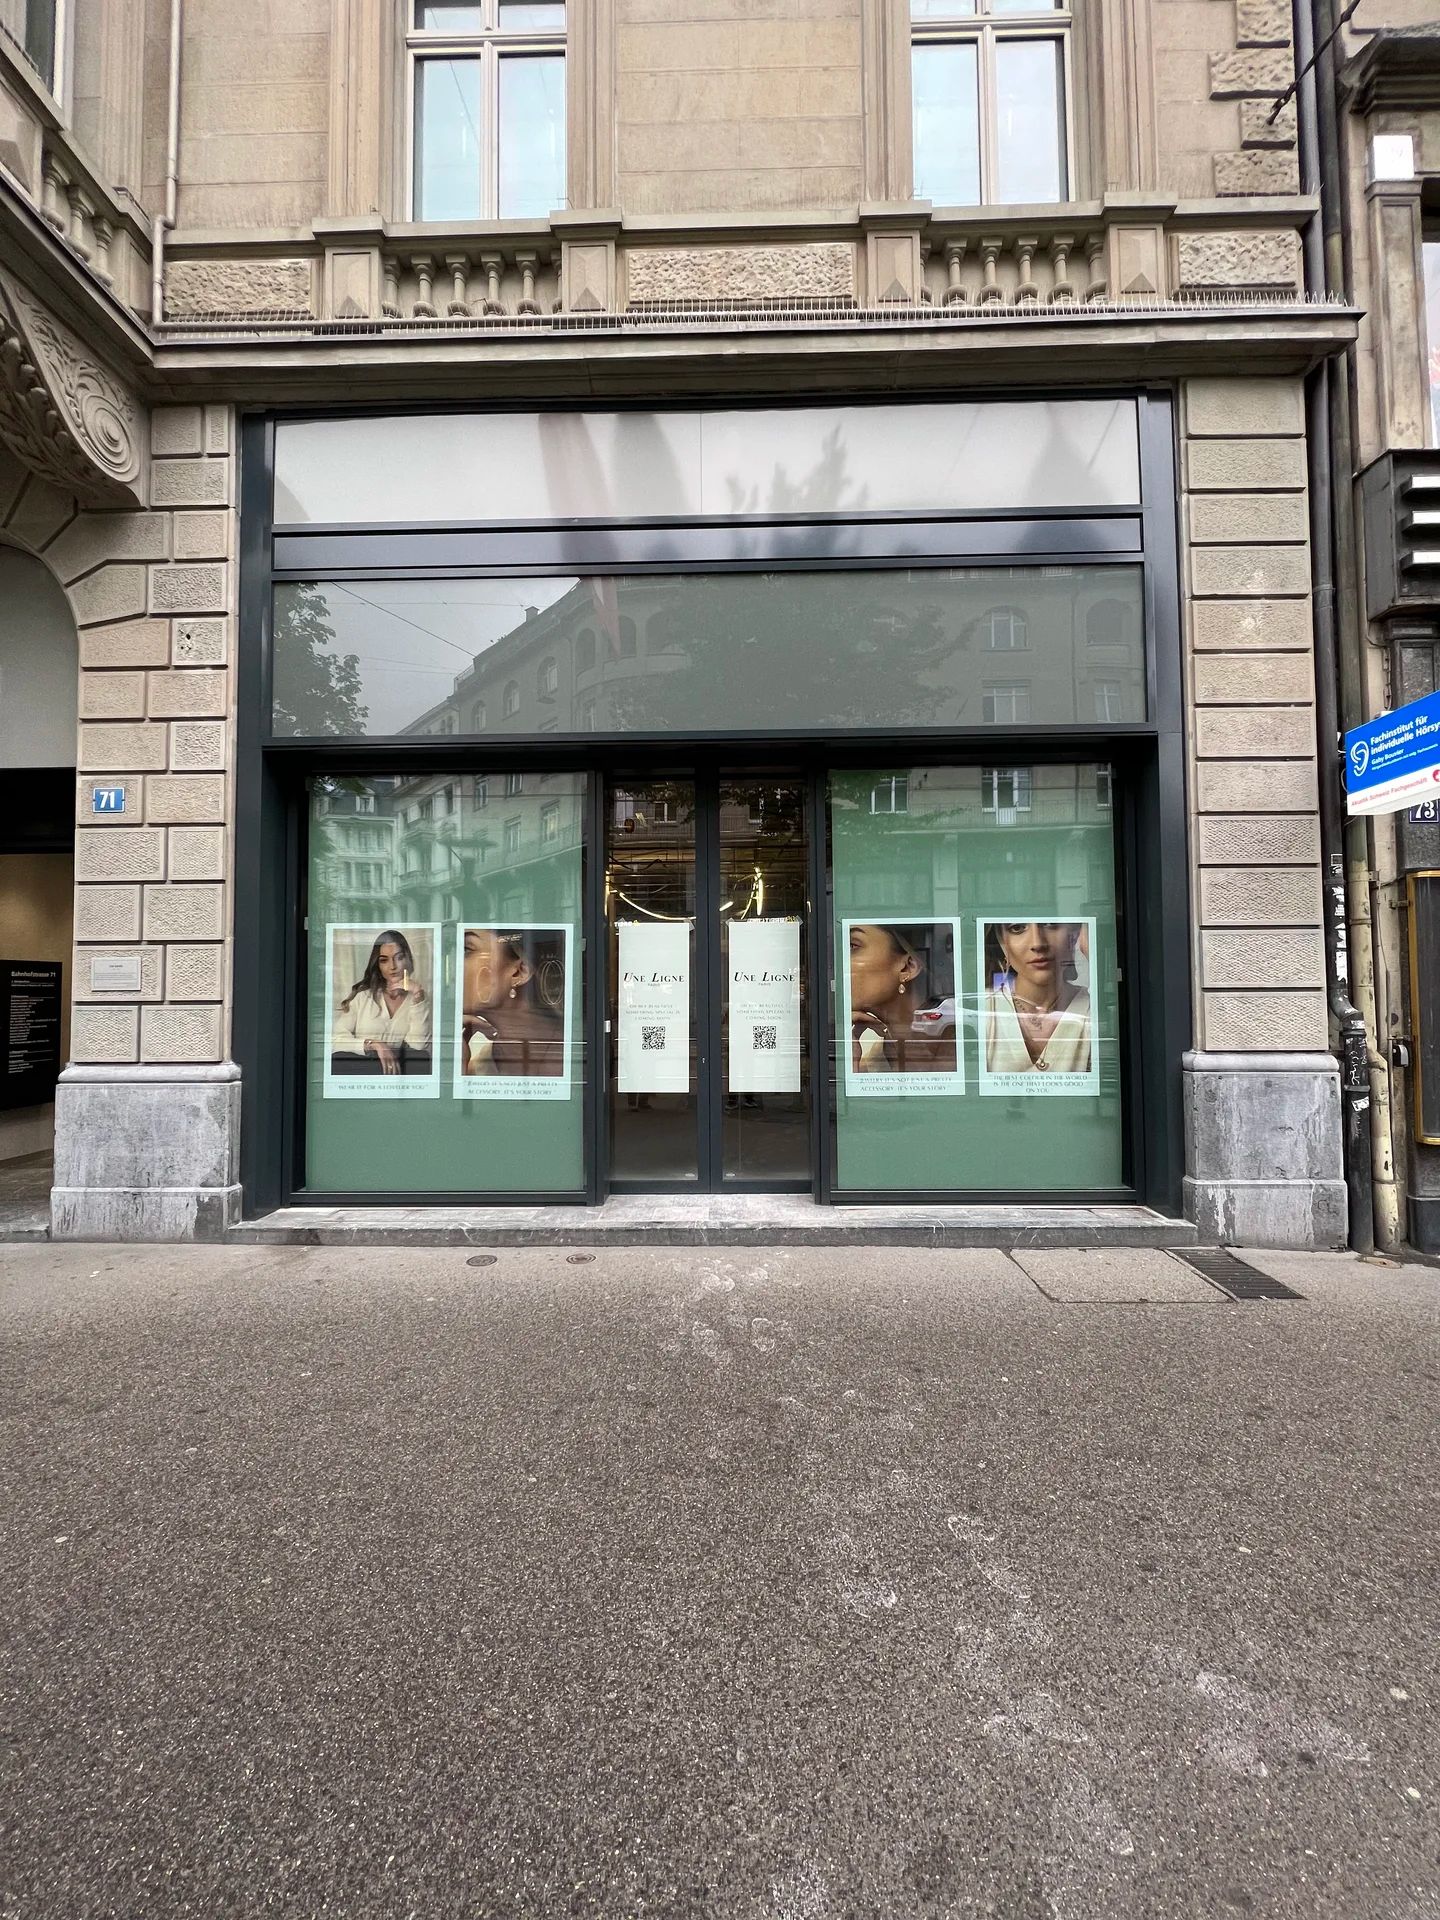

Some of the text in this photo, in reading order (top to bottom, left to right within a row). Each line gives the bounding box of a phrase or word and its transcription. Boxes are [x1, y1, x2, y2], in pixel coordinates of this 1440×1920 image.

[1370, 715, 1428, 745] Fachinstitut für
[1370, 732, 1414, 755] individuelle
[1371, 756, 1384, 765] Gaby
[1384, 749, 1404, 760] Bouvier
[1369, 790, 1390, 801] Schweiz
[1391, 777, 1428, 793] Fachgeschäft
[99, 791, 115, 809] 71
[1415, 801, 1435, 819] 73
[624, 972, 685, 983] UNE LIGNE
[733, 971, 795, 982] UNE LIGNE
